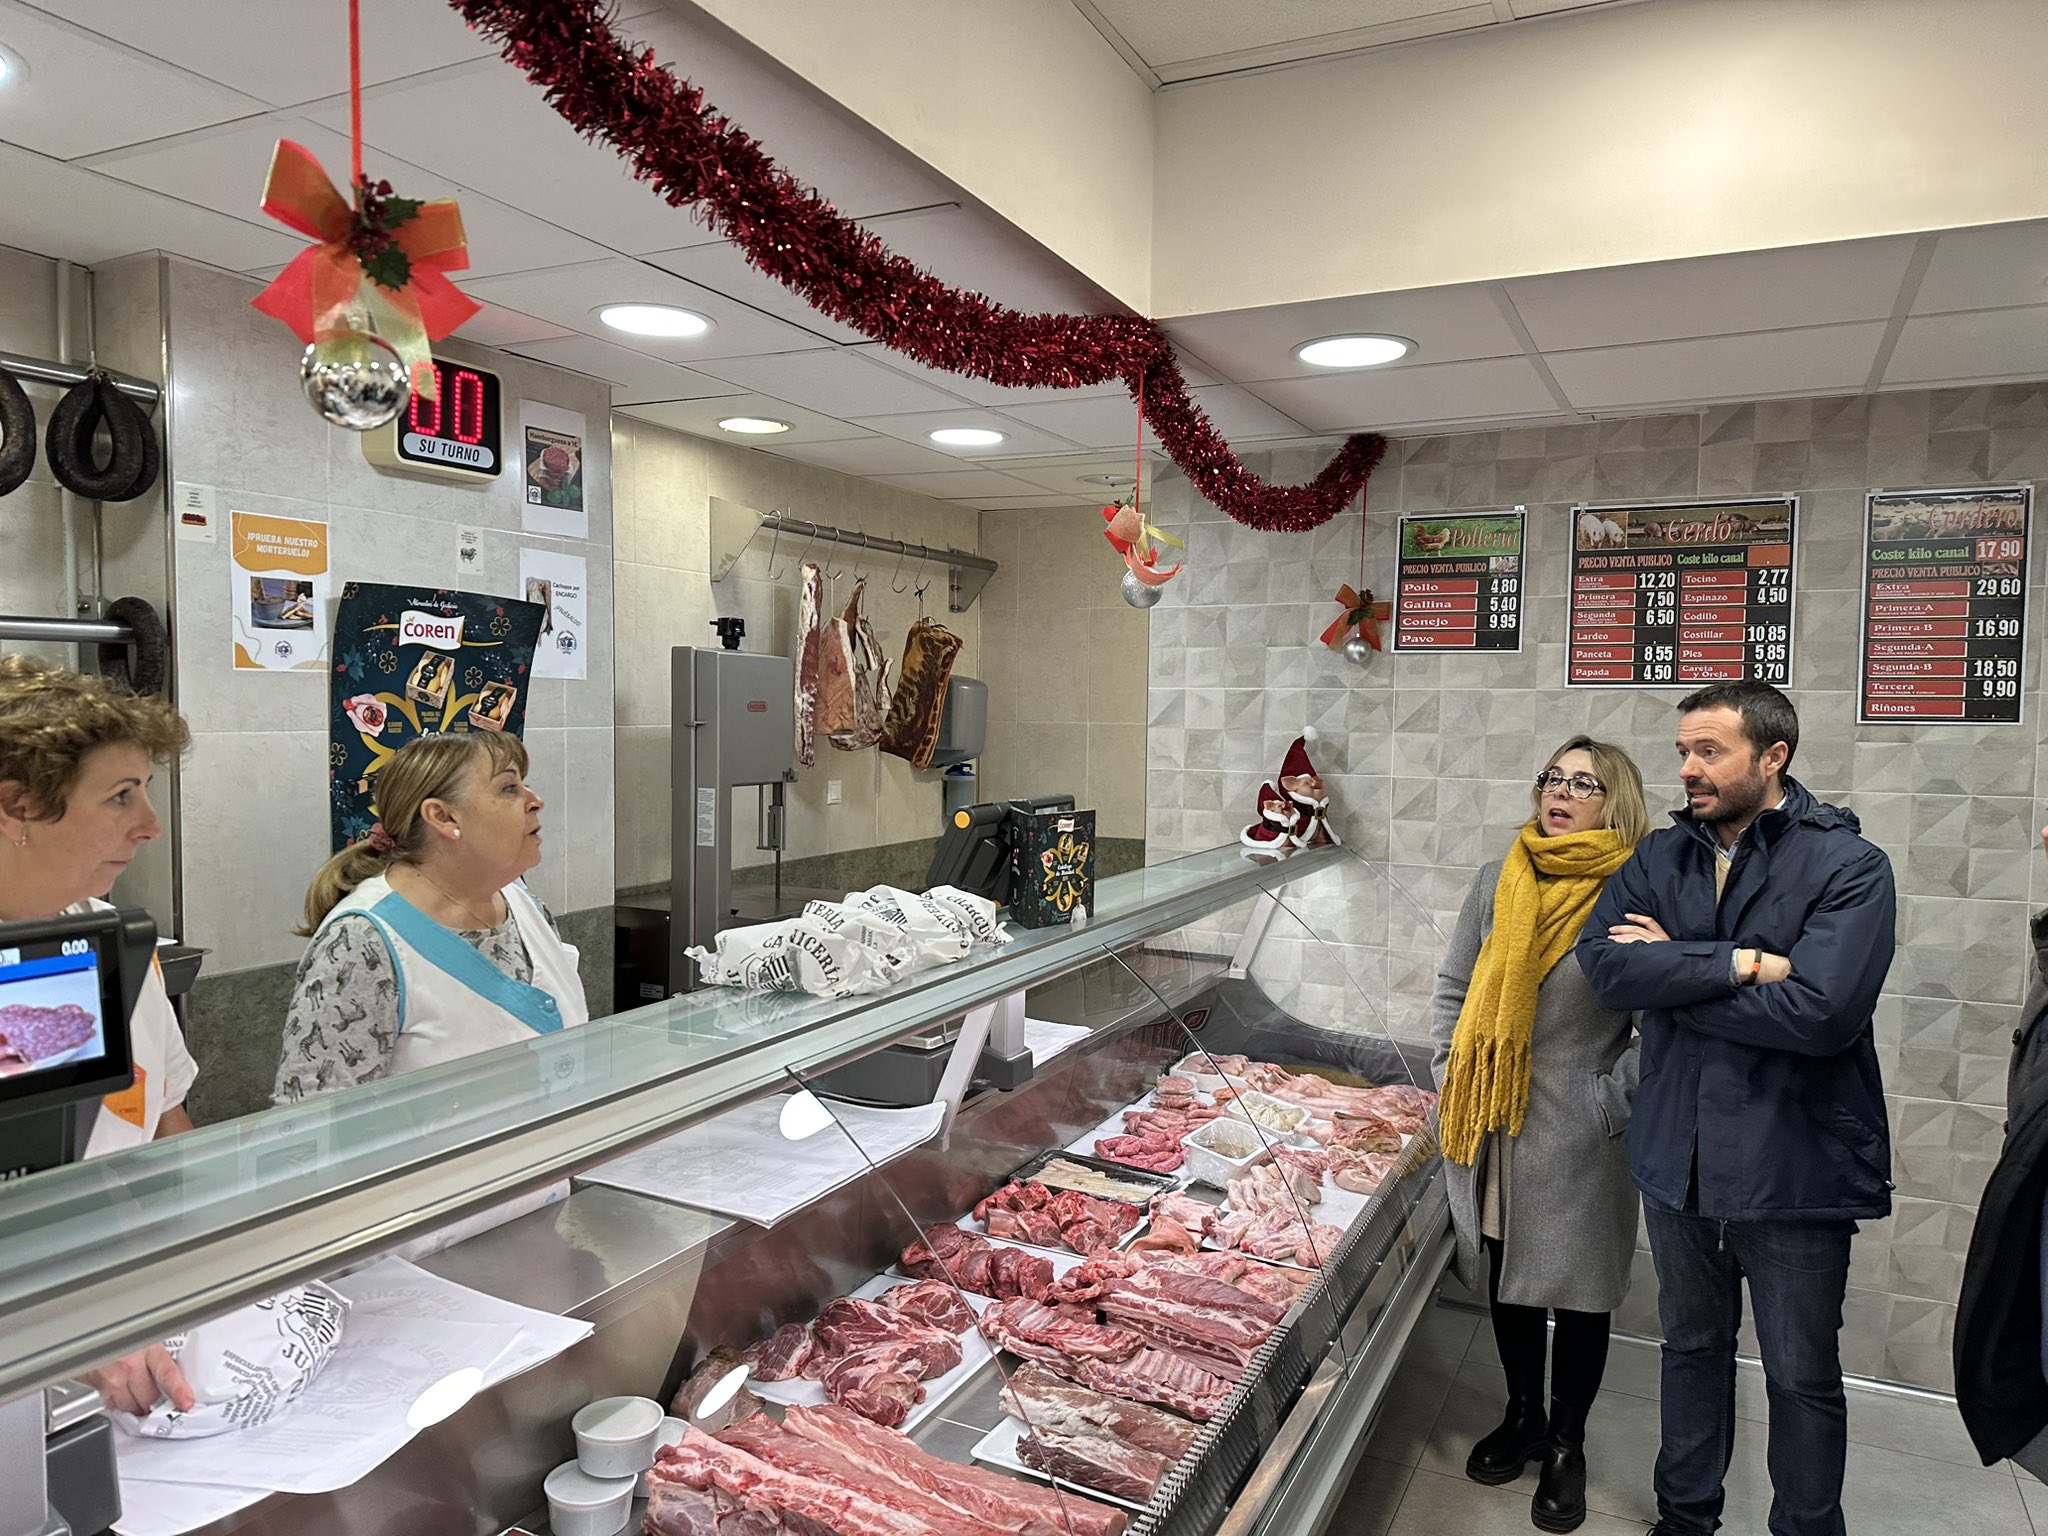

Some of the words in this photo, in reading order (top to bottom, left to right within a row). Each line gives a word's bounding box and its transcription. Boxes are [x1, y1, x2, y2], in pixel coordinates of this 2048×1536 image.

[529, 431, 566, 446] Hamburguesa
[419, 438, 436, 454] SU
[441, 442, 480, 462] TURNO
[1928, 499, 2018, 532] Cordero
[1665, 511, 1732, 544] Cerdo
[1450, 522, 1518, 550] Pollería
[284, 537, 319, 548] NUESTRO
[1871, 548, 1905, 561] Coste
[1907, 547, 1933, 559] kilo
[1934, 546, 1969, 558] canal
[1578, 556, 1608, 569] PRECIO
[1610, 555, 1636, 568] VENTA
[1637, 554, 1673, 567] PUBLICO
[1677, 553, 1700, 565] Coste
[1702, 552, 1719, 564] kilo
[1720, 552, 1744, 563] canal
[1403, 563, 1429, 575] PRECIO
[1430, 563, 1454, 574] VENTA
[1455, 562, 1487, 573] PUBLICO
[1872, 567, 1905, 580] PRECIO
[1907, 566, 1938, 578] VENTA
[1939, 565, 1981, 577] PUBLICO
[1685, 575, 1717, 583] Tocino
[1404, 583, 1439, 592] Pollo
[1876, 583, 1910, 591] Extra
[555, 591, 578, 599] ENCARGO
[1577, 593, 1616, 601] Primera
[1684, 594, 1728, 602] Espinazo
[1403, 600, 1452, 609] Gallina
[1874, 604, 1934, 612] Primera-A
[1577, 611, 1616, 620] Segunda
[1683, 612, 1718, 621] Codillo
[1402, 618, 1449, 628] Conejo
[1873, 624, 1933, 632] Primera-B
[1401, 634, 1435, 643] Pavo
[1576, 632, 1608, 640] Lardeo
[1683, 630, 1724, 639] Costillar
[1873, 643, 1934, 652] Segunda-A
[1576, 650, 1612, 658] Panceta
[1682, 649, 1703, 658] Pies
[1682, 665, 1713, 673] Careta
[1872, 662, 1933, 671] Segunda-B
[1575, 668, 1610, 677] Papada
[1693, 671, 1699, 679] y
[1702, 670, 1728, 679] Oreja
[1872, 683, 1915, 691] Tercera
[1871, 703, 1916, 713] Riñones
